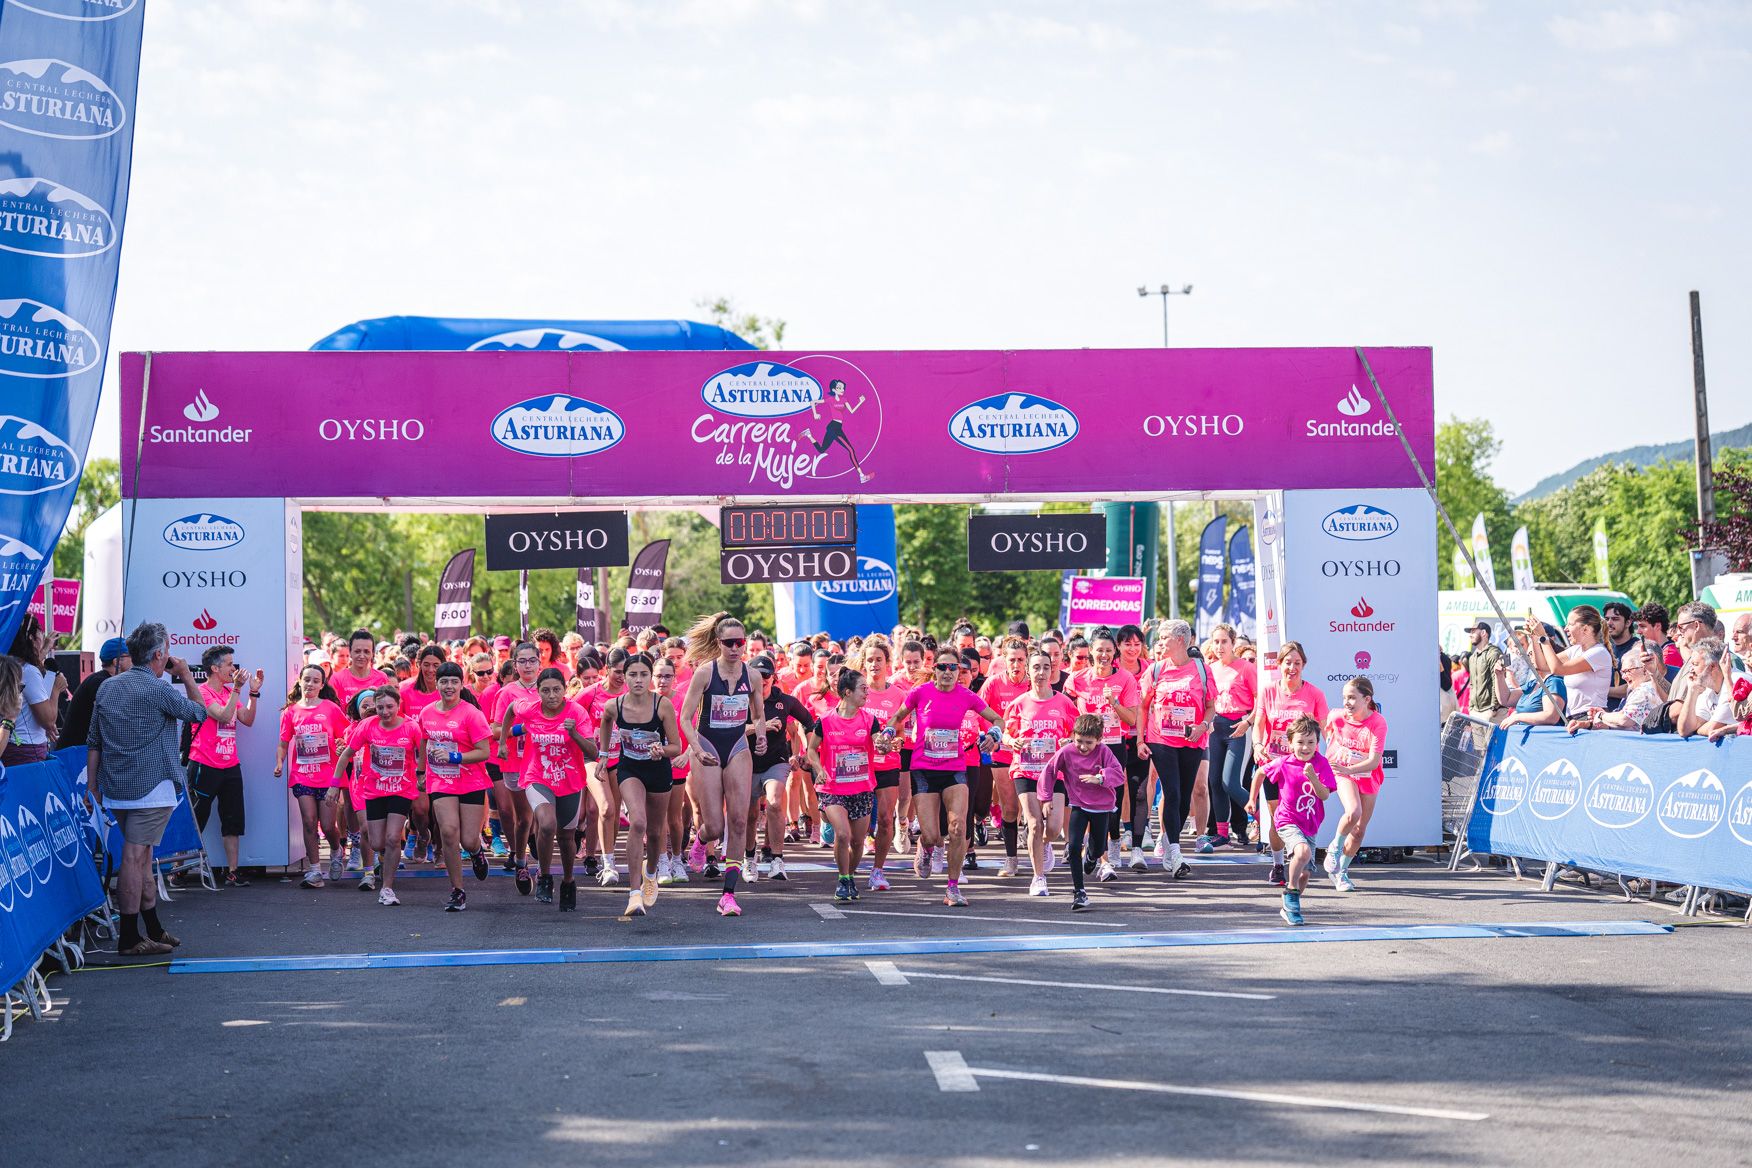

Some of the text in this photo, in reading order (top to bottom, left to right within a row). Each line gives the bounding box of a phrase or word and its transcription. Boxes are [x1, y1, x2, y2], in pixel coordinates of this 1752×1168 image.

[7, 80, 112, 105] CENTRAL LECHERA
[0, 91, 114, 128] STURIANA
[2, 200, 102, 223] ENTRAL LECHERA
[0, 211, 104, 247] TURIANA
[3, 323, 84, 343] TRAL LECHERA
[0, 335, 85, 366] URIANA
[710, 382, 813, 403] ASTURIANA
[150, 425, 253, 443] Santander
[319, 418, 425, 441] OYSHO
[502, 417, 615, 440] ASTURIANA
[691, 414, 791, 443] Carrera
[959, 416, 1069, 438] ASTURIANA
[1143, 414, 1244, 436] OYSHO
[20, 444, 64, 458] LECHERA
[0, 454, 66, 481] RIANA
[715, 441, 829, 489] de la Mujer
[169, 527, 239, 541] ASTURIANA
[1328, 518, 1393, 532] ASTURIANA
[508, 528, 609, 552] OYSHO
[990, 532, 1088, 553] OYSHO
[635, 568, 662, 577] OYSHO
[727, 551, 850, 580] OYSHO
[1322, 559, 1401, 577] OYSHO
[162, 570, 247, 588] OYSHO
[443, 581, 470, 590] OYSHO
[1113, 584, 1142, 592] OYSHO
[54, 587, 78, 595] OYSHO
[27, 602, 76, 616] RREORAS
[1072, 599, 1142, 612] CORREDORAS
[1446, 601, 1516, 611] AMBULACIA
[1329, 620, 1396, 633] Santander
[170, 633, 240, 645] Santander
[531, 733, 565, 744] CARRERA
[550, 745, 561, 756] DE
[1483, 778, 1523, 801] ASTURIANA
[1531, 779, 1575, 805] ASTURIANA
[1588, 784, 1647, 814] ASTURIANA
[1661, 791, 1719, 821] ASTURIANA
